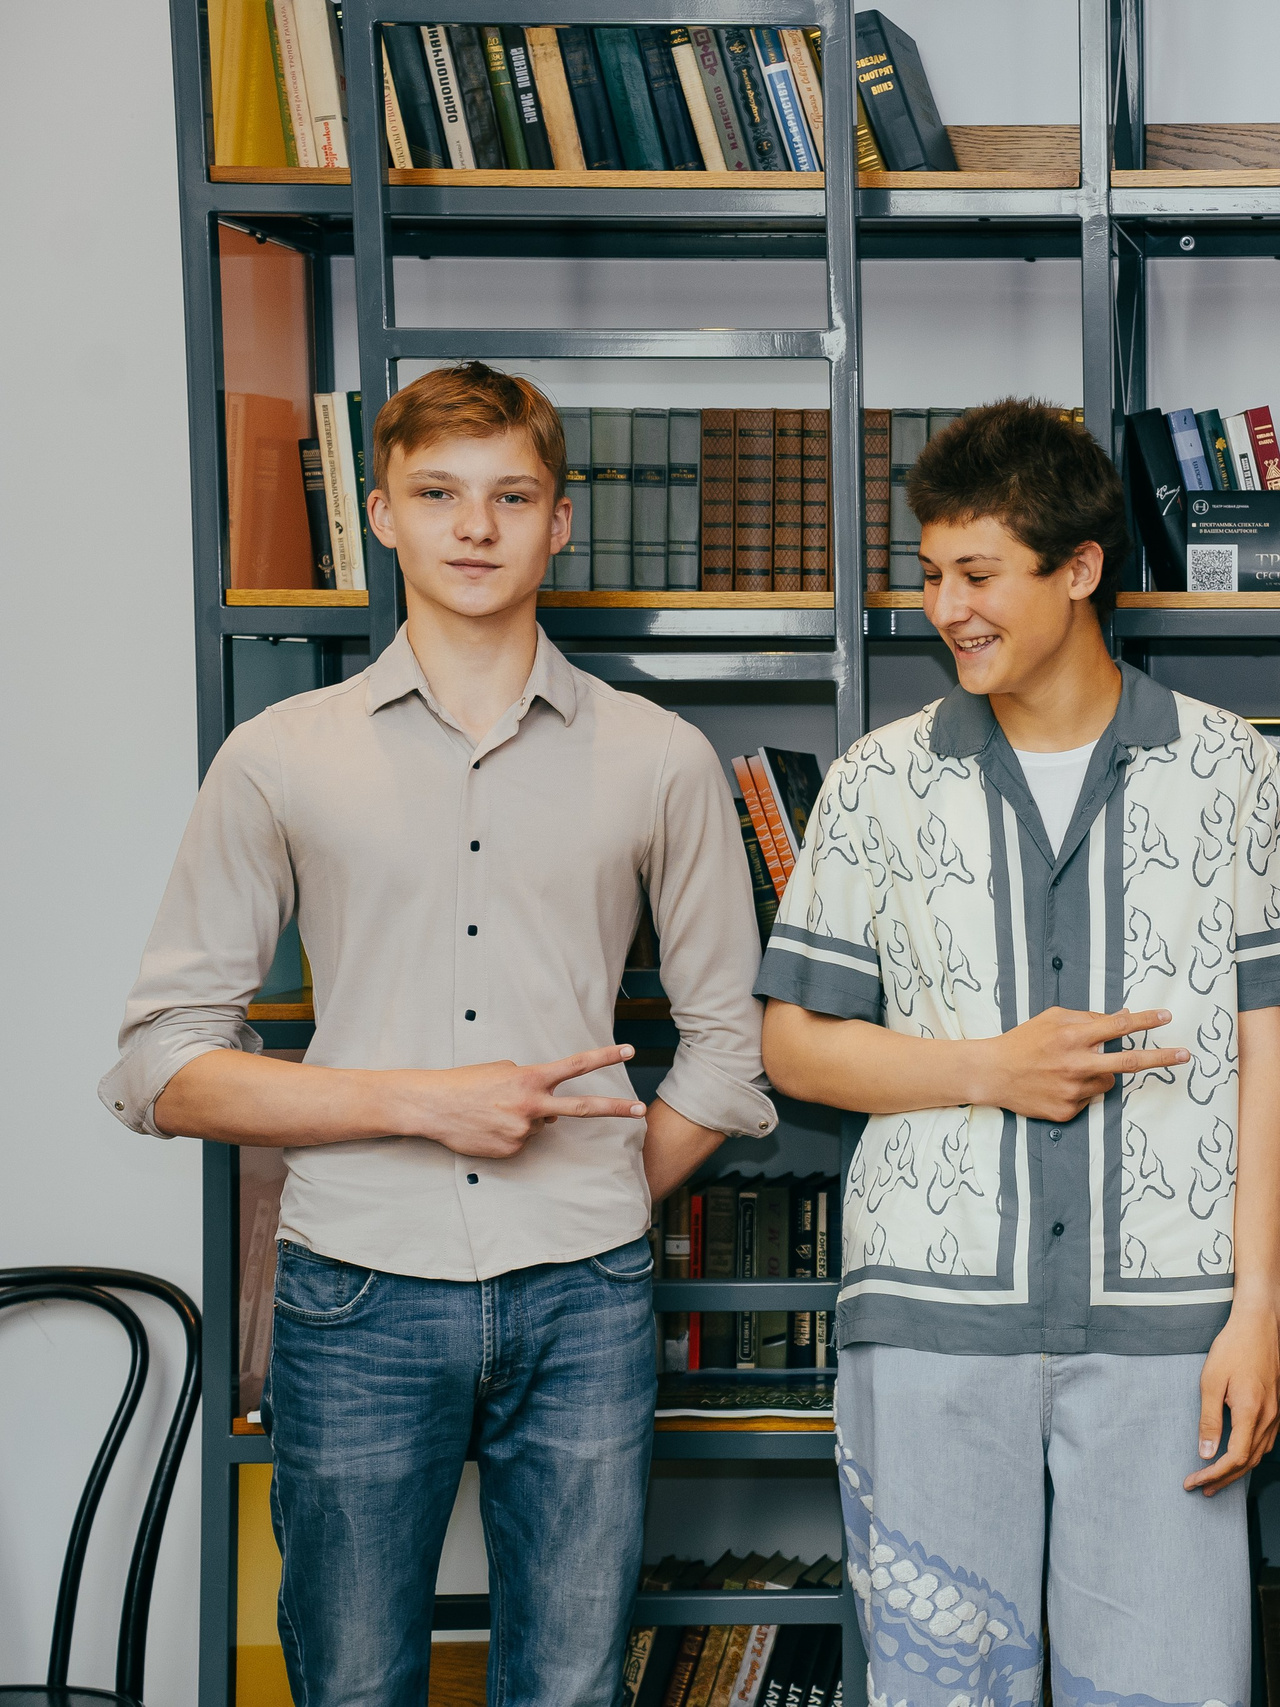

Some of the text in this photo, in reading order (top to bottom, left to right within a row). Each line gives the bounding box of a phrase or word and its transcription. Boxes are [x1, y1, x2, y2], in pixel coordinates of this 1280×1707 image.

[281, 5, 290, 36] ГАЙДАРА
[286, 38, 295, 69] ТРОПОЙ
[855, 53, 887, 69] ЗВЕЗДЫ
[509, 46, 538, 124] БОРИС ПОЛЕВОЙ
[858, 64, 894, 83] СМОТРЯТ
[870, 81, 894, 96] ВНИЗ
[291, 71, 304, 126] ПАРТИЗАНСКОЙ
[776, 81, 810, 171] КНИГА БРАТСТВА
[321, 404, 335, 458] ПРОИЗВЕДЕНИЯ
[328, 459, 341, 518] ДРАМАТИЧЕСКИЕ
[742, 787, 764, 819] 2023
[758, 787, 778, 817] 2023
[755, 822, 781, 870] МАСКА
[771, 822, 795, 868] МАСКА
